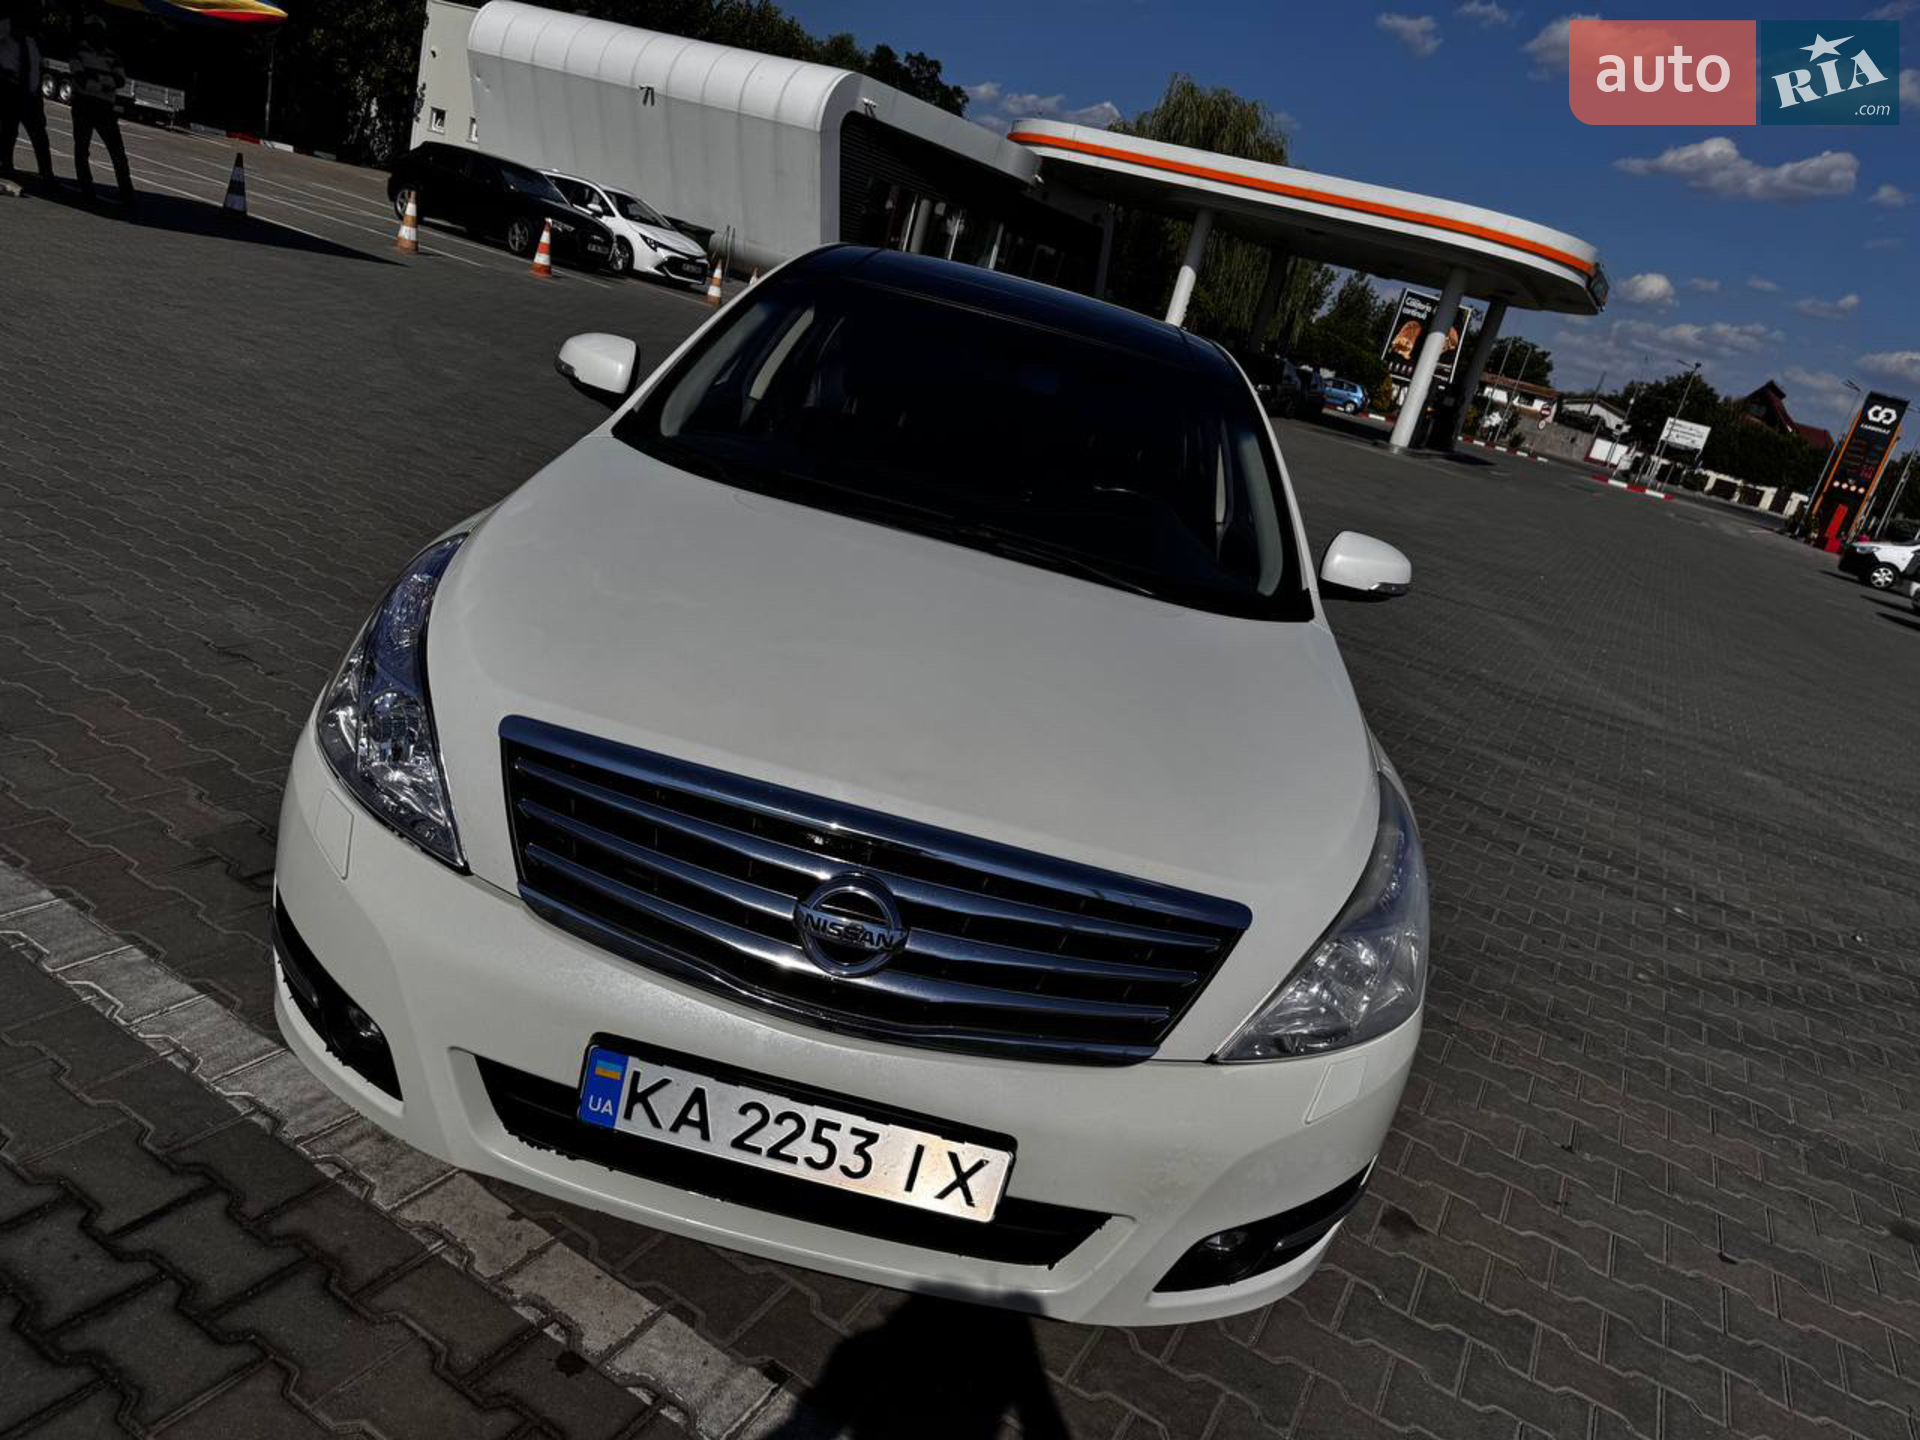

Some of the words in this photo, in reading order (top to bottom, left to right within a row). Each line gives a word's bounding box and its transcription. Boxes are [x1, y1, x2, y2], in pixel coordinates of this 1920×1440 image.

[803, 912, 894, 948] NISSAN
[588, 1095, 613, 1117] UA
[623, 1070, 711, 1142] KA
[730, 1101, 880, 1180] 2253
[903, 1143, 990, 1208] IX
